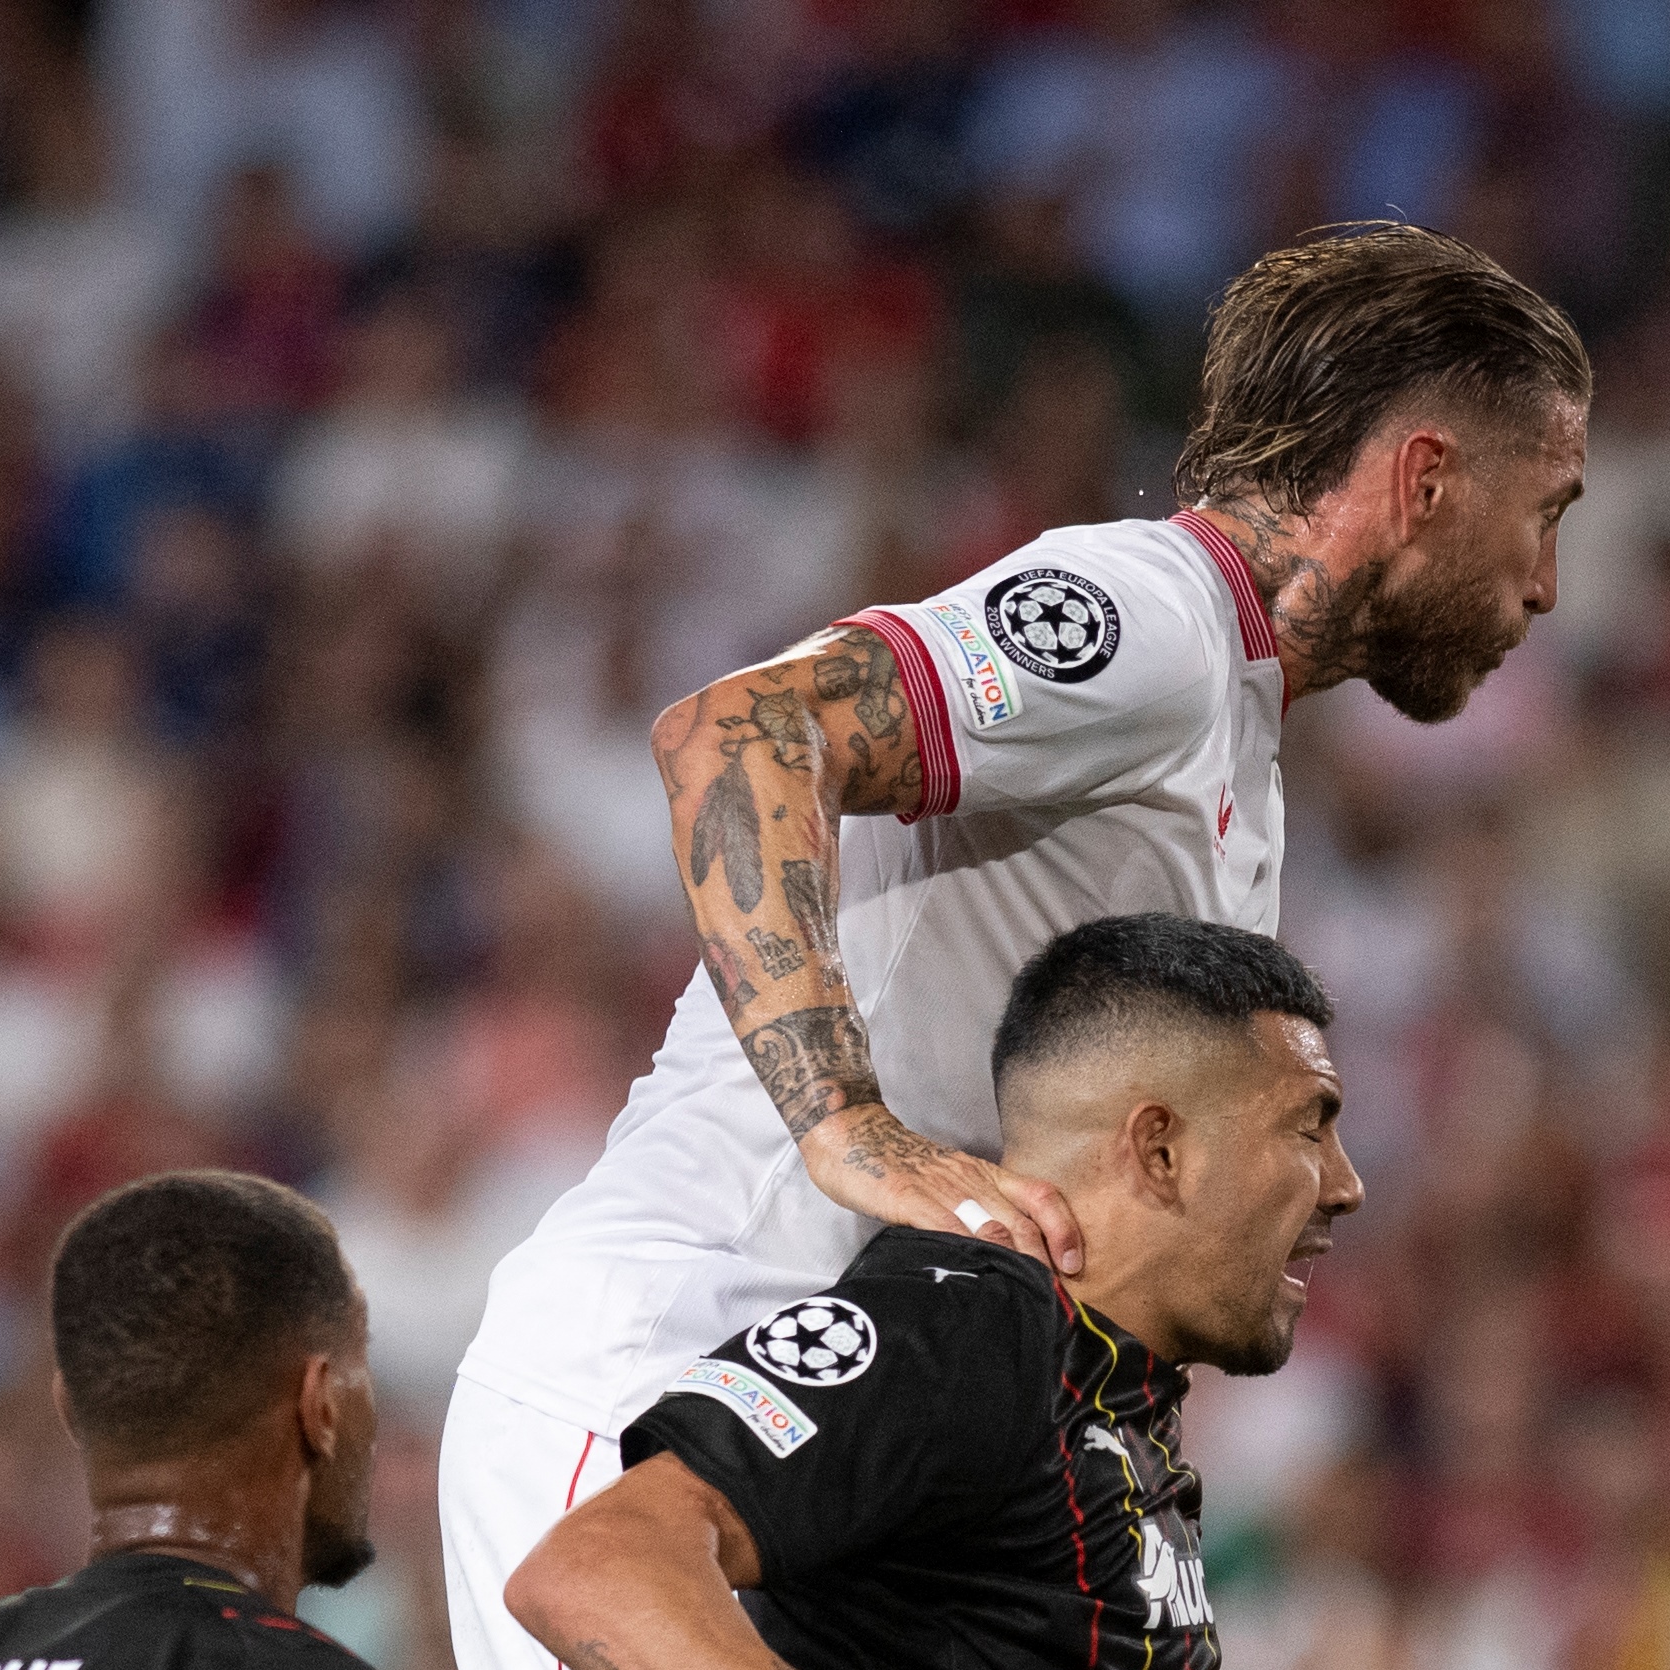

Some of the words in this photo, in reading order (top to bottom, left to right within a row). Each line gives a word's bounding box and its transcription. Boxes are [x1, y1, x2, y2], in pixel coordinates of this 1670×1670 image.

[987, 606, 1004, 637] 2023
[999, 638, 1055, 679] WINNERS
[1018, 569, 1055, 582] UEFA
[1059, 571, 1109, 605] EUROPA
[1099, 605, 1118, 659] LEAGUE
[931, 605, 1008, 721] FOUNDATION
[683, 1367, 804, 1444] FOUNDATION
